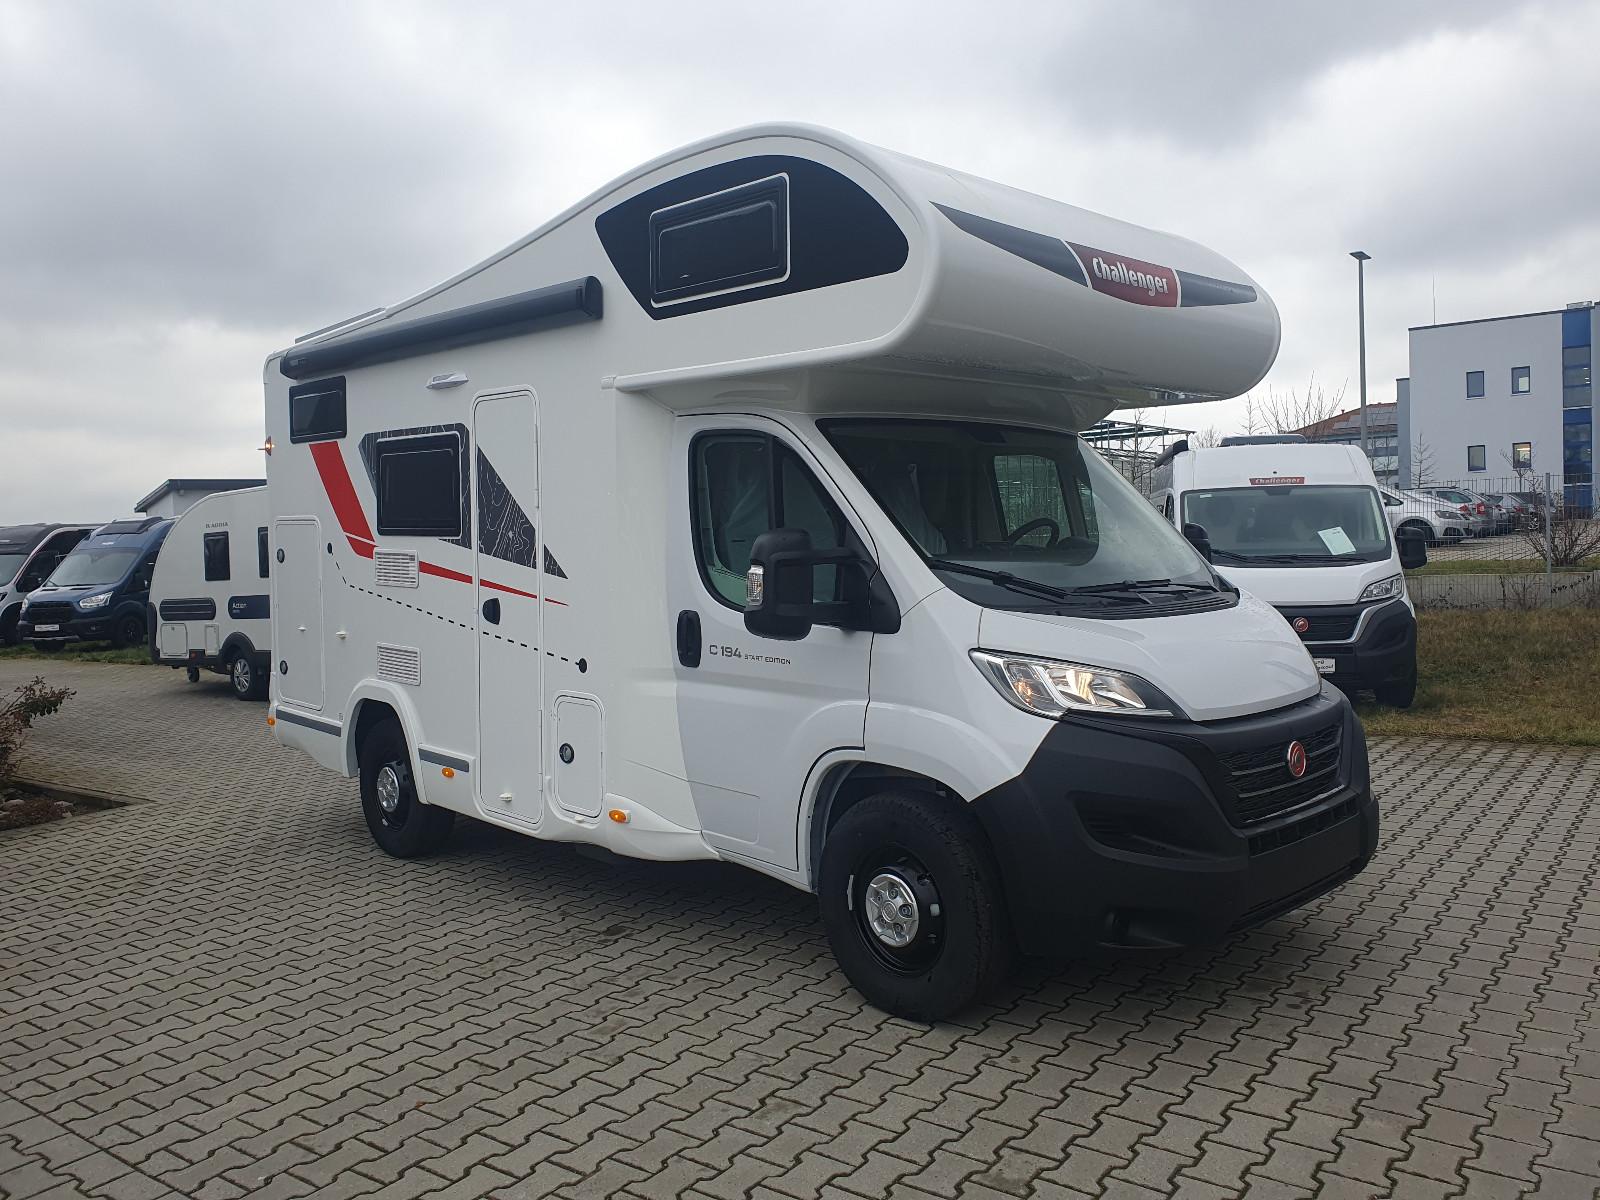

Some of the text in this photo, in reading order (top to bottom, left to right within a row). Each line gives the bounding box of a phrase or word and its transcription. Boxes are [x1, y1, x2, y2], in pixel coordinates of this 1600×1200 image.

[1092, 256, 1169, 297] Challenger
[709, 644, 791, 665] C 194 START EDITION
